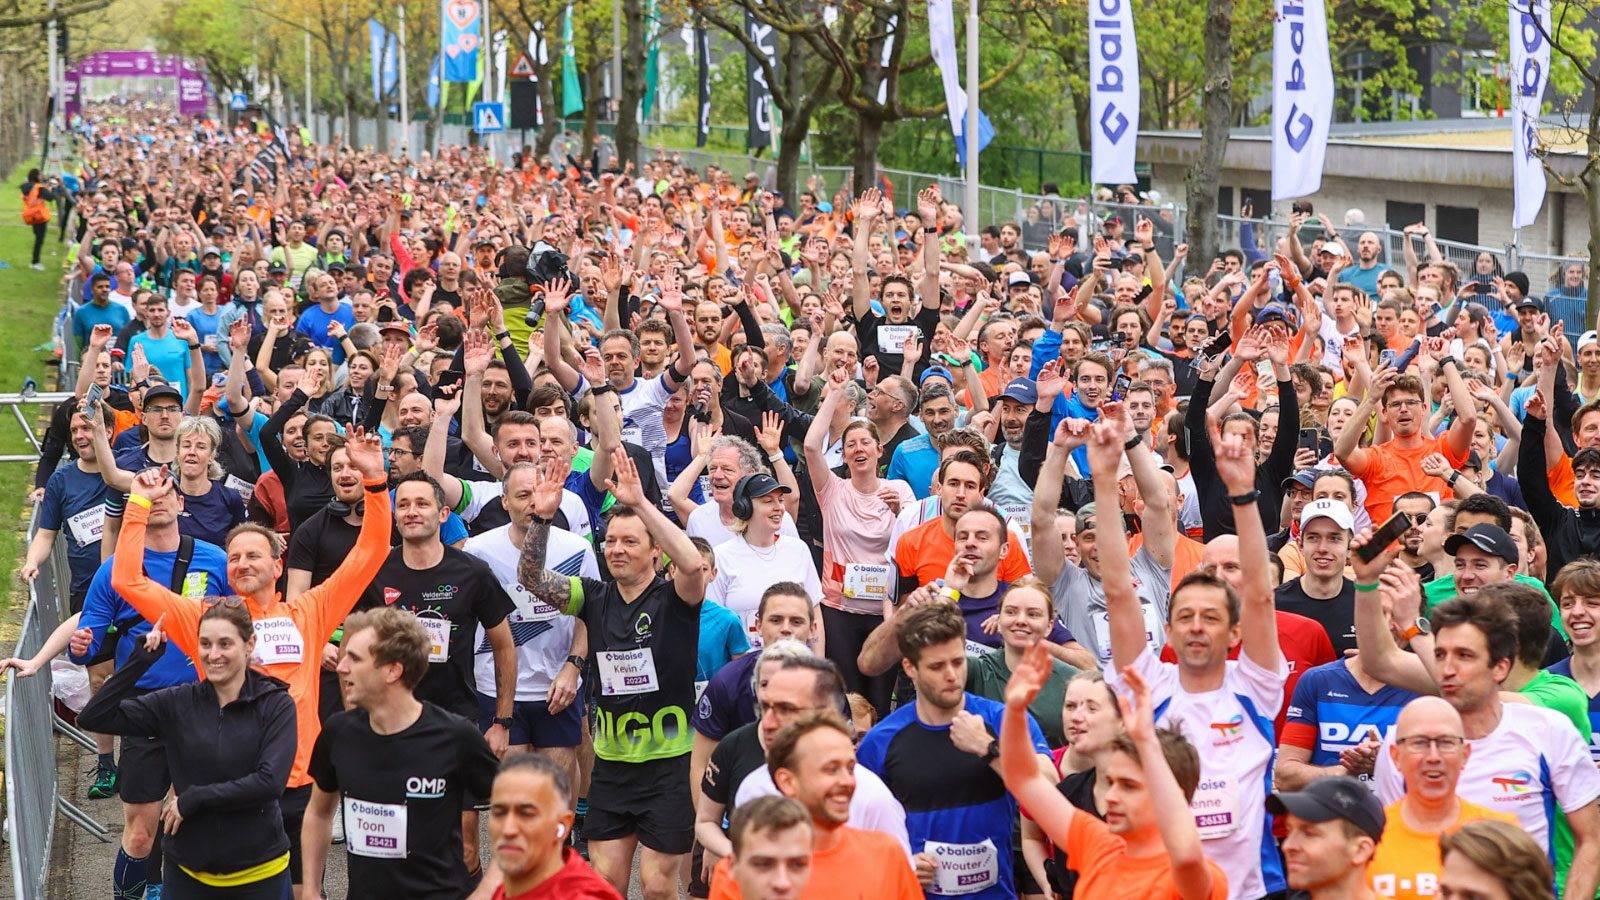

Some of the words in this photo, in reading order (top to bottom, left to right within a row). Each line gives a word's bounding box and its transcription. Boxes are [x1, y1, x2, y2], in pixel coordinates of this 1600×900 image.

[78, 507, 103, 520] baloise
[860, 565, 887, 573] baloise
[860, 574, 878, 583] Lien
[263, 633, 291, 643] Davy
[966, 643, 986, 655] oise
[613, 652, 643, 661] baloise
[613, 665, 638, 674] Kevin
[626, 675, 647, 684] 20224
[1190, 798, 1221, 809] enne
[359, 803, 395, 817] baloise
[357, 818, 385, 832] Toon
[369, 837, 394, 847] 25421
[947, 846, 987, 856] baloise
[941, 861, 982, 870] Wouter
